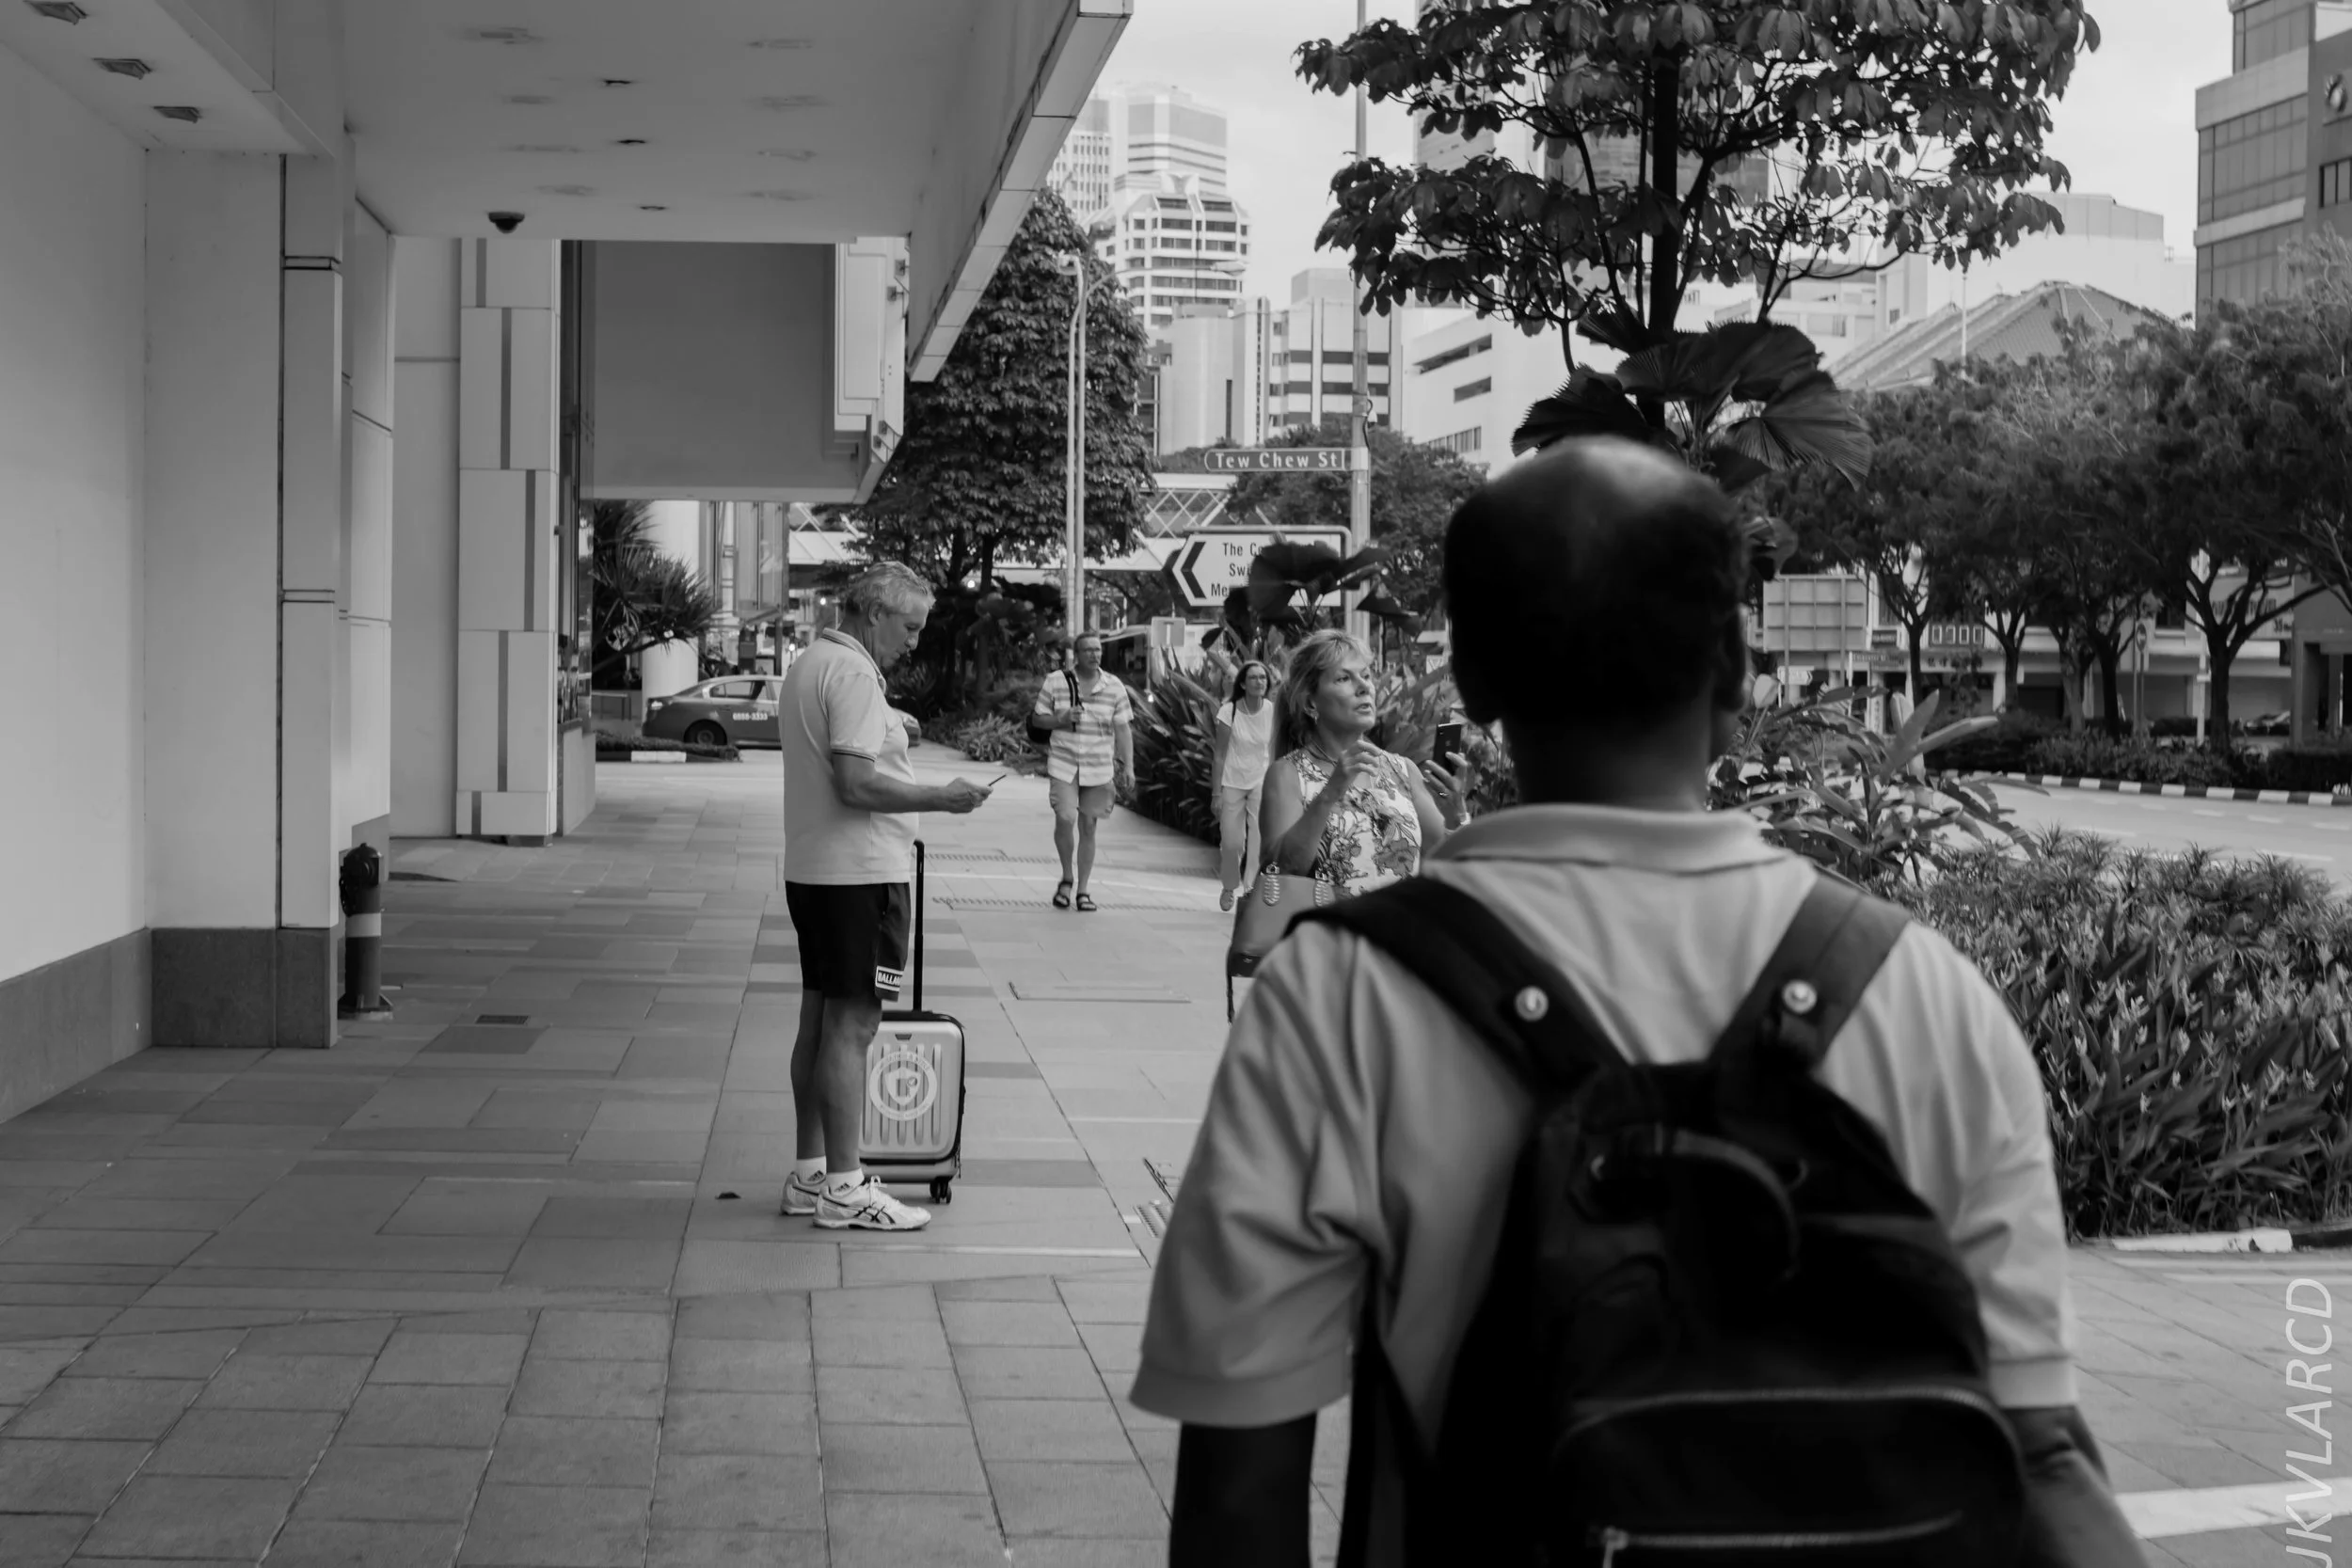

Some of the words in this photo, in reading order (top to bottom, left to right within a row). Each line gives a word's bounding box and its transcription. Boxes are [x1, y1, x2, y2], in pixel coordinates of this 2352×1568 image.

[1216, 452, 1249, 468] Tew
[1259, 451, 1309, 468] Chew
[1318, 451, 1337, 468] St
[1223, 543, 1243, 556] The
